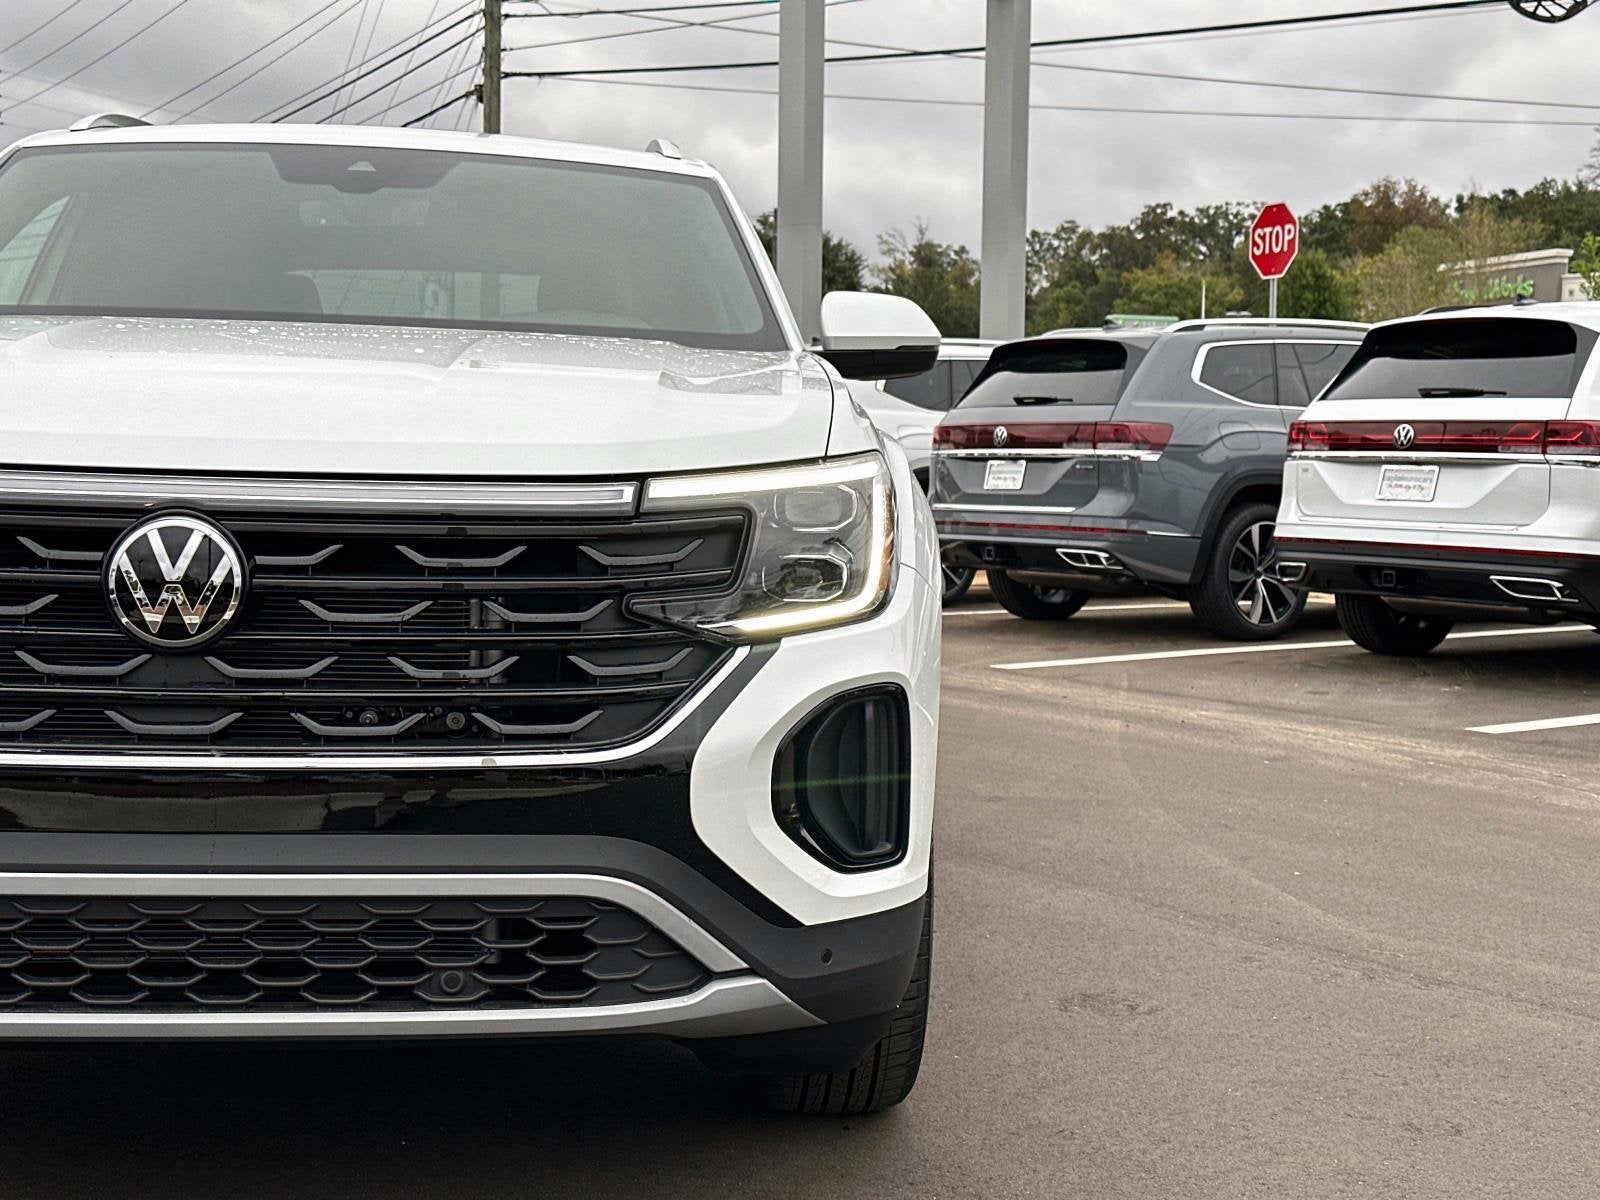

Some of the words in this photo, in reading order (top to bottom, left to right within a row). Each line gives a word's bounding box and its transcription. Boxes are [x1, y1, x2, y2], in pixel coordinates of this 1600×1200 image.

[1253, 223, 1295, 256] STOP
[1395, 424, 1414, 447] VW
[116, 524, 235, 635] VW
